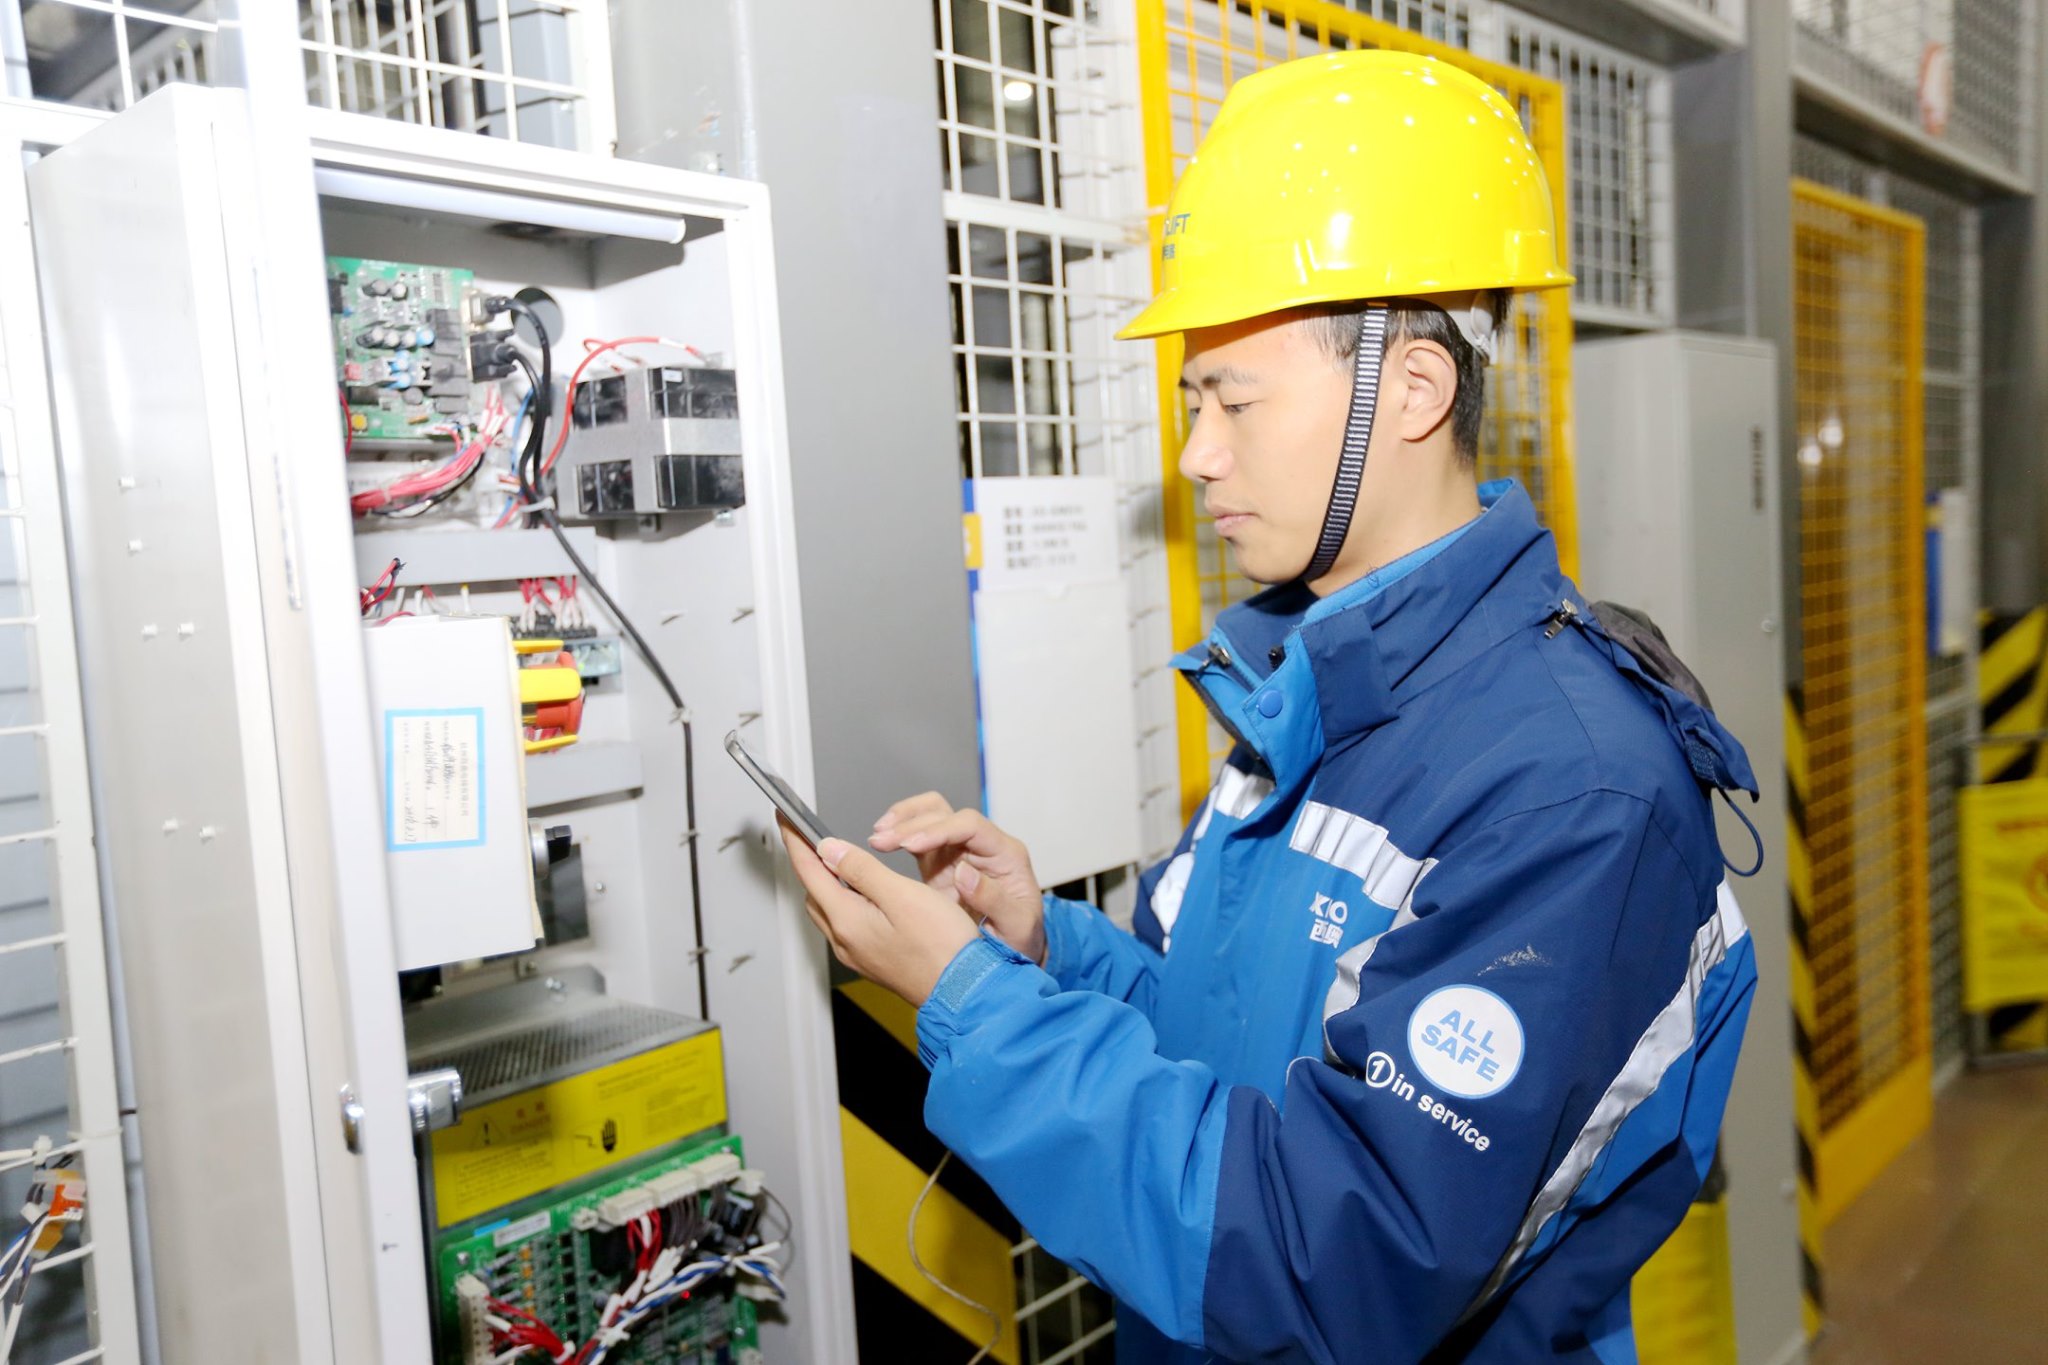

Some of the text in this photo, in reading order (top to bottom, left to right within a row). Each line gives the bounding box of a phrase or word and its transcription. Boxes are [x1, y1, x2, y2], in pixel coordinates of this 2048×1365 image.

[1421, 1024, 1501, 1082] SAFE
[1439, 1009, 1495, 1055] ALL
[1391, 1073, 1415, 1101] in
[1417, 1094, 1490, 1152] service
